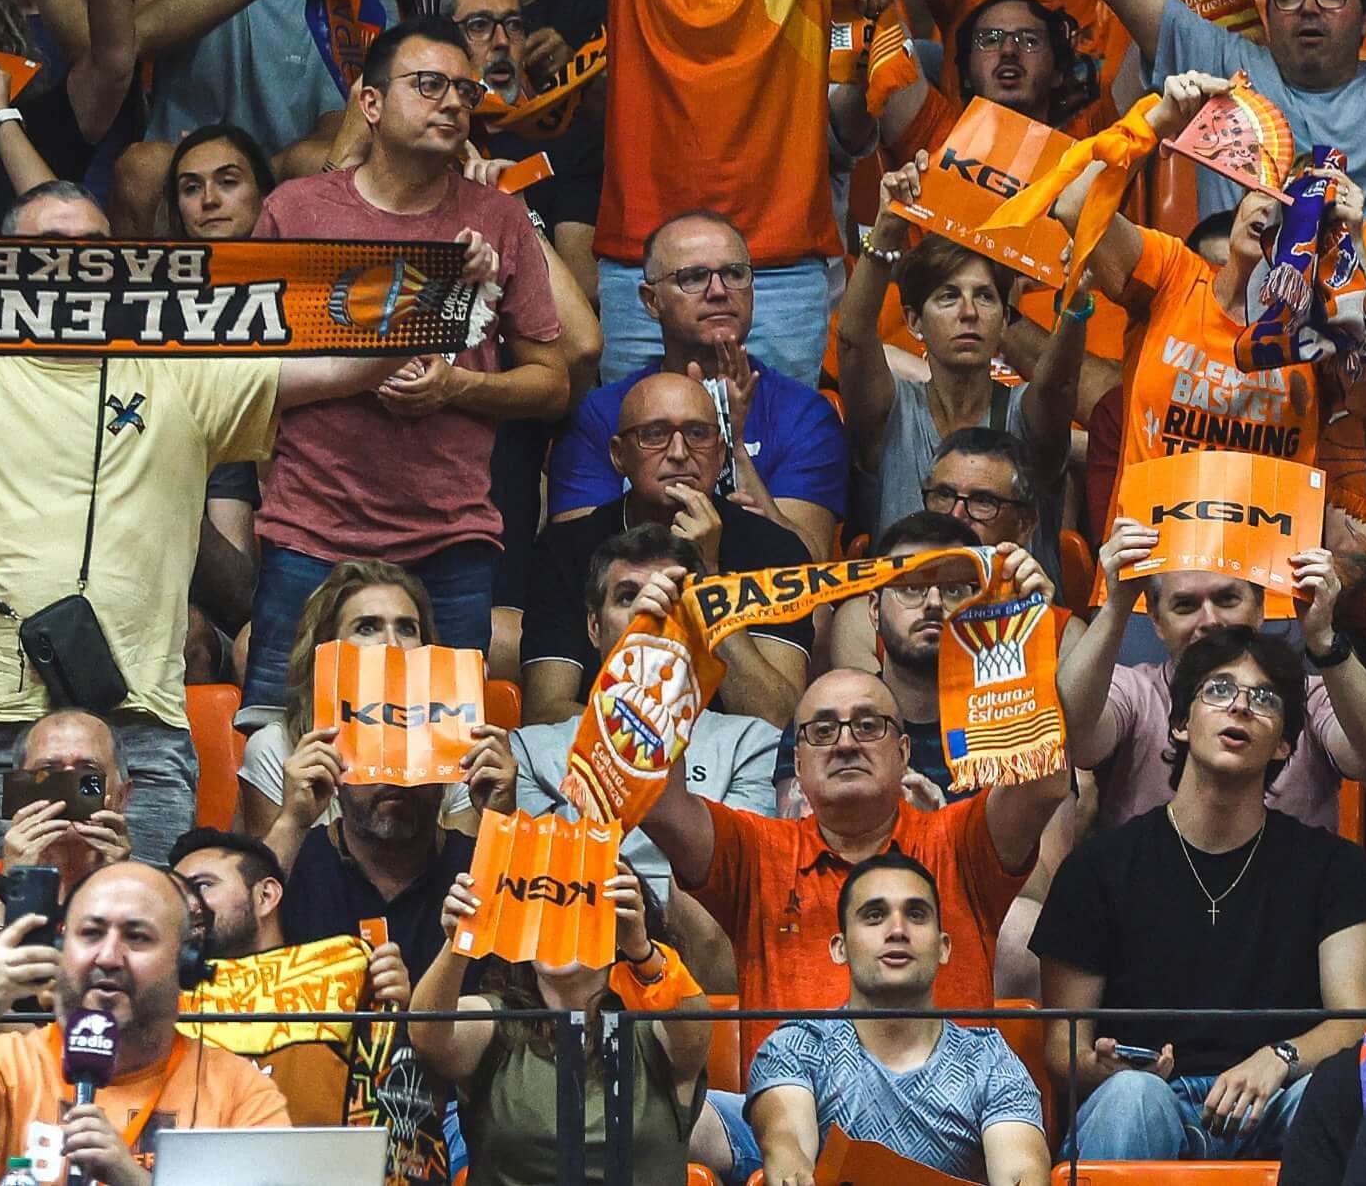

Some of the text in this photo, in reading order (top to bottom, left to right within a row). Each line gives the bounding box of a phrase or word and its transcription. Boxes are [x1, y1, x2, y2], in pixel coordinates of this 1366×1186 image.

[938, 147, 1030, 201] KG
[1163, 403, 1301, 457] RUNNING
[1151, 499, 1293, 537] KGM
[697, 555, 910, 629] BASKET
[967, 698, 1037, 724] Esfuerzo
[968, 688, 1023, 707] Cultura
[341, 700, 476, 728] KGM
[495, 875, 596, 907] KGM
[68, 1034, 114, 1051] radio
